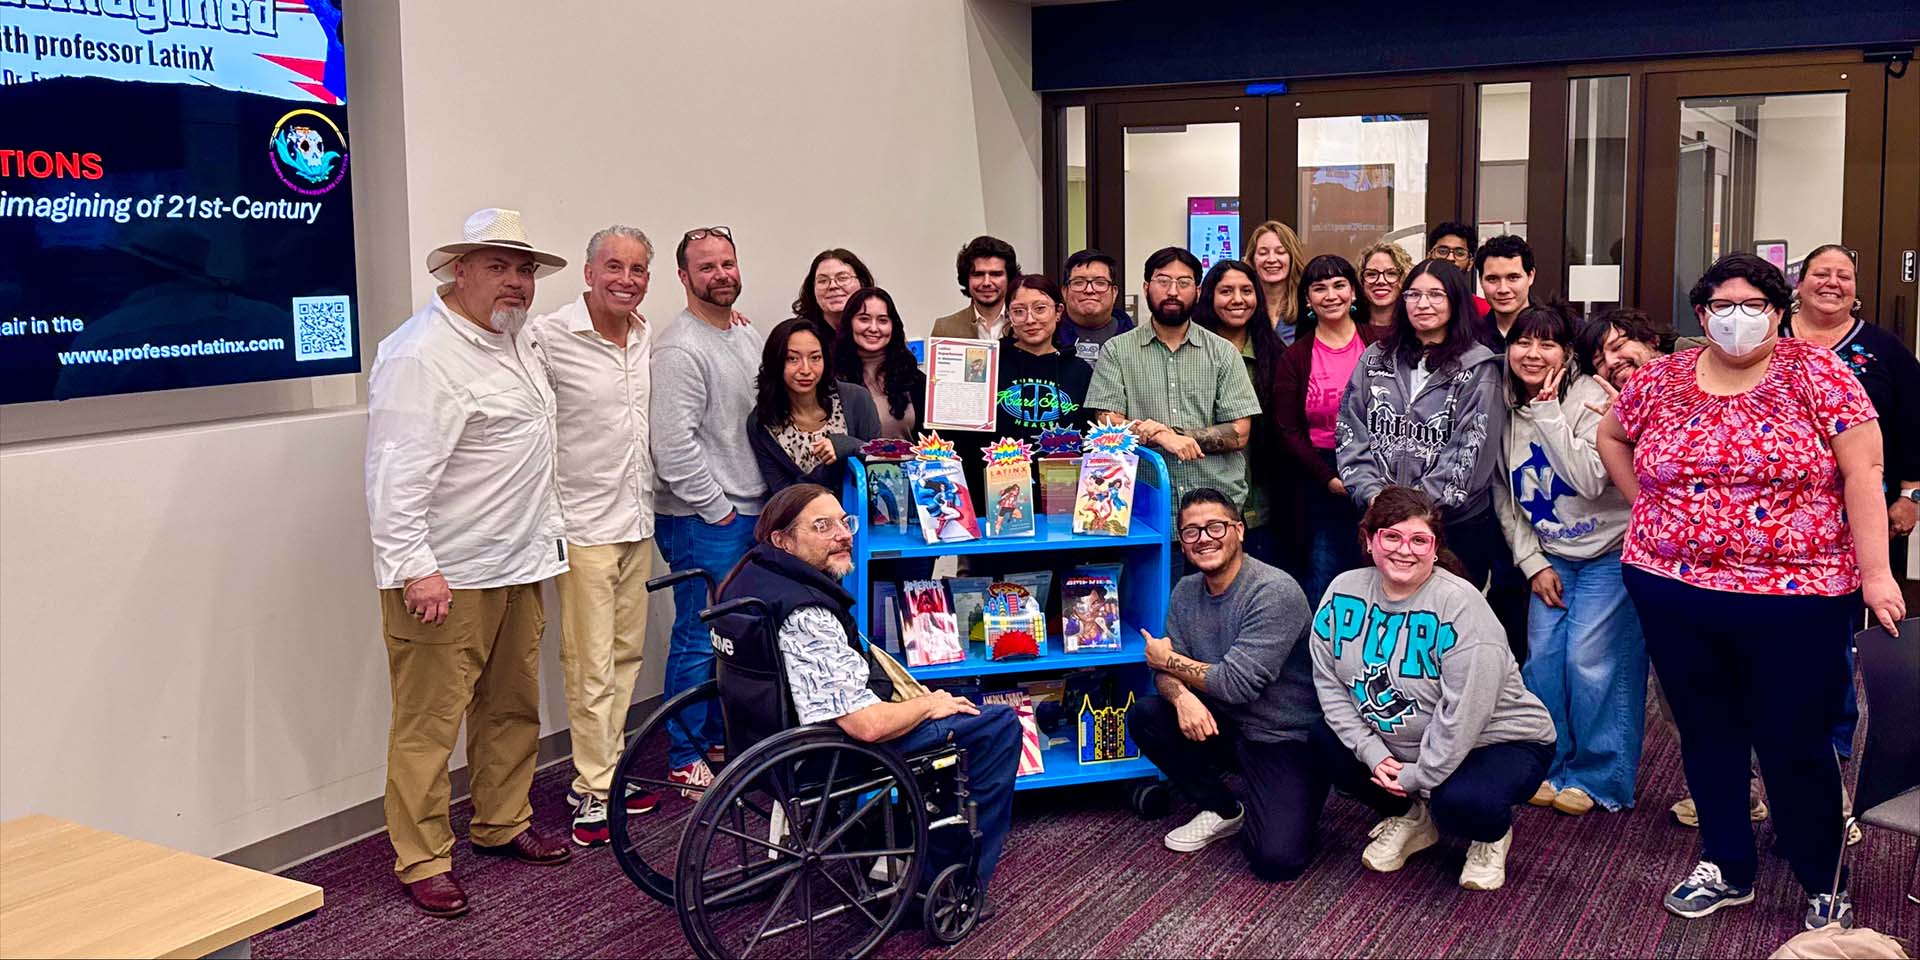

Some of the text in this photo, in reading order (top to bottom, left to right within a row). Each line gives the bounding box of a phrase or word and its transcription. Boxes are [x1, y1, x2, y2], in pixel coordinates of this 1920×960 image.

[34, 33, 143, 65] professor
[147, 40, 215, 72] LatinX
[0, 149, 104, 180] TIONS
[0, 190, 322, 224] imagining of 21st-Century
[1905, 252, 1913, 281] PULL
[0, 316, 84, 336] air in the
[58, 337, 285, 365] www.professorlatinx.com
[989, 467, 1027, 477] LATINX
